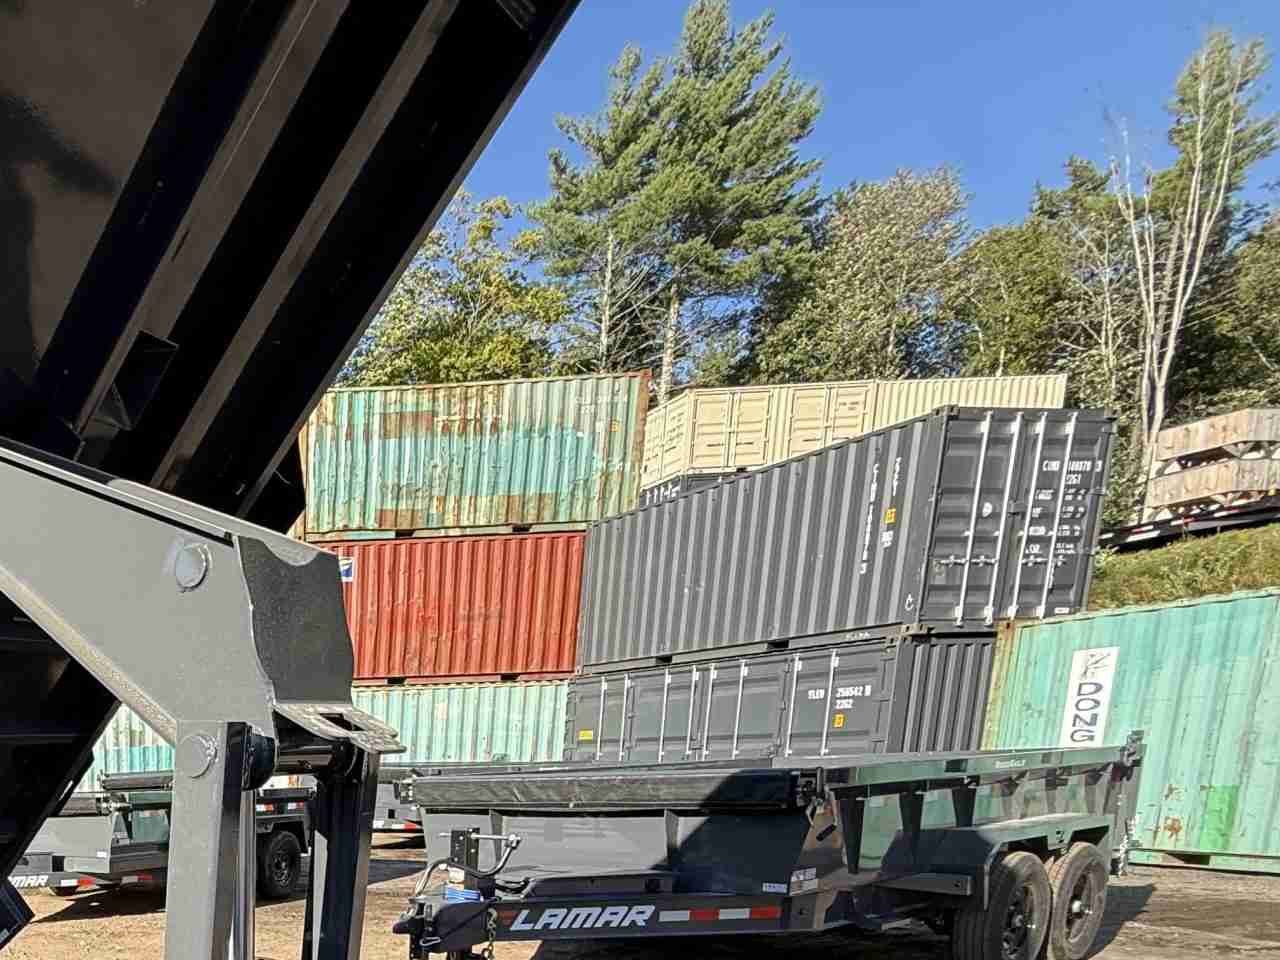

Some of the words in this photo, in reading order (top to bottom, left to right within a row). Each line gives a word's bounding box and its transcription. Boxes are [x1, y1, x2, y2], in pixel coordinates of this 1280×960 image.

[1070, 682, 1104, 743] DONG
[8, 875, 49, 888] MAR
[510, 904, 656, 931] LAMAR
